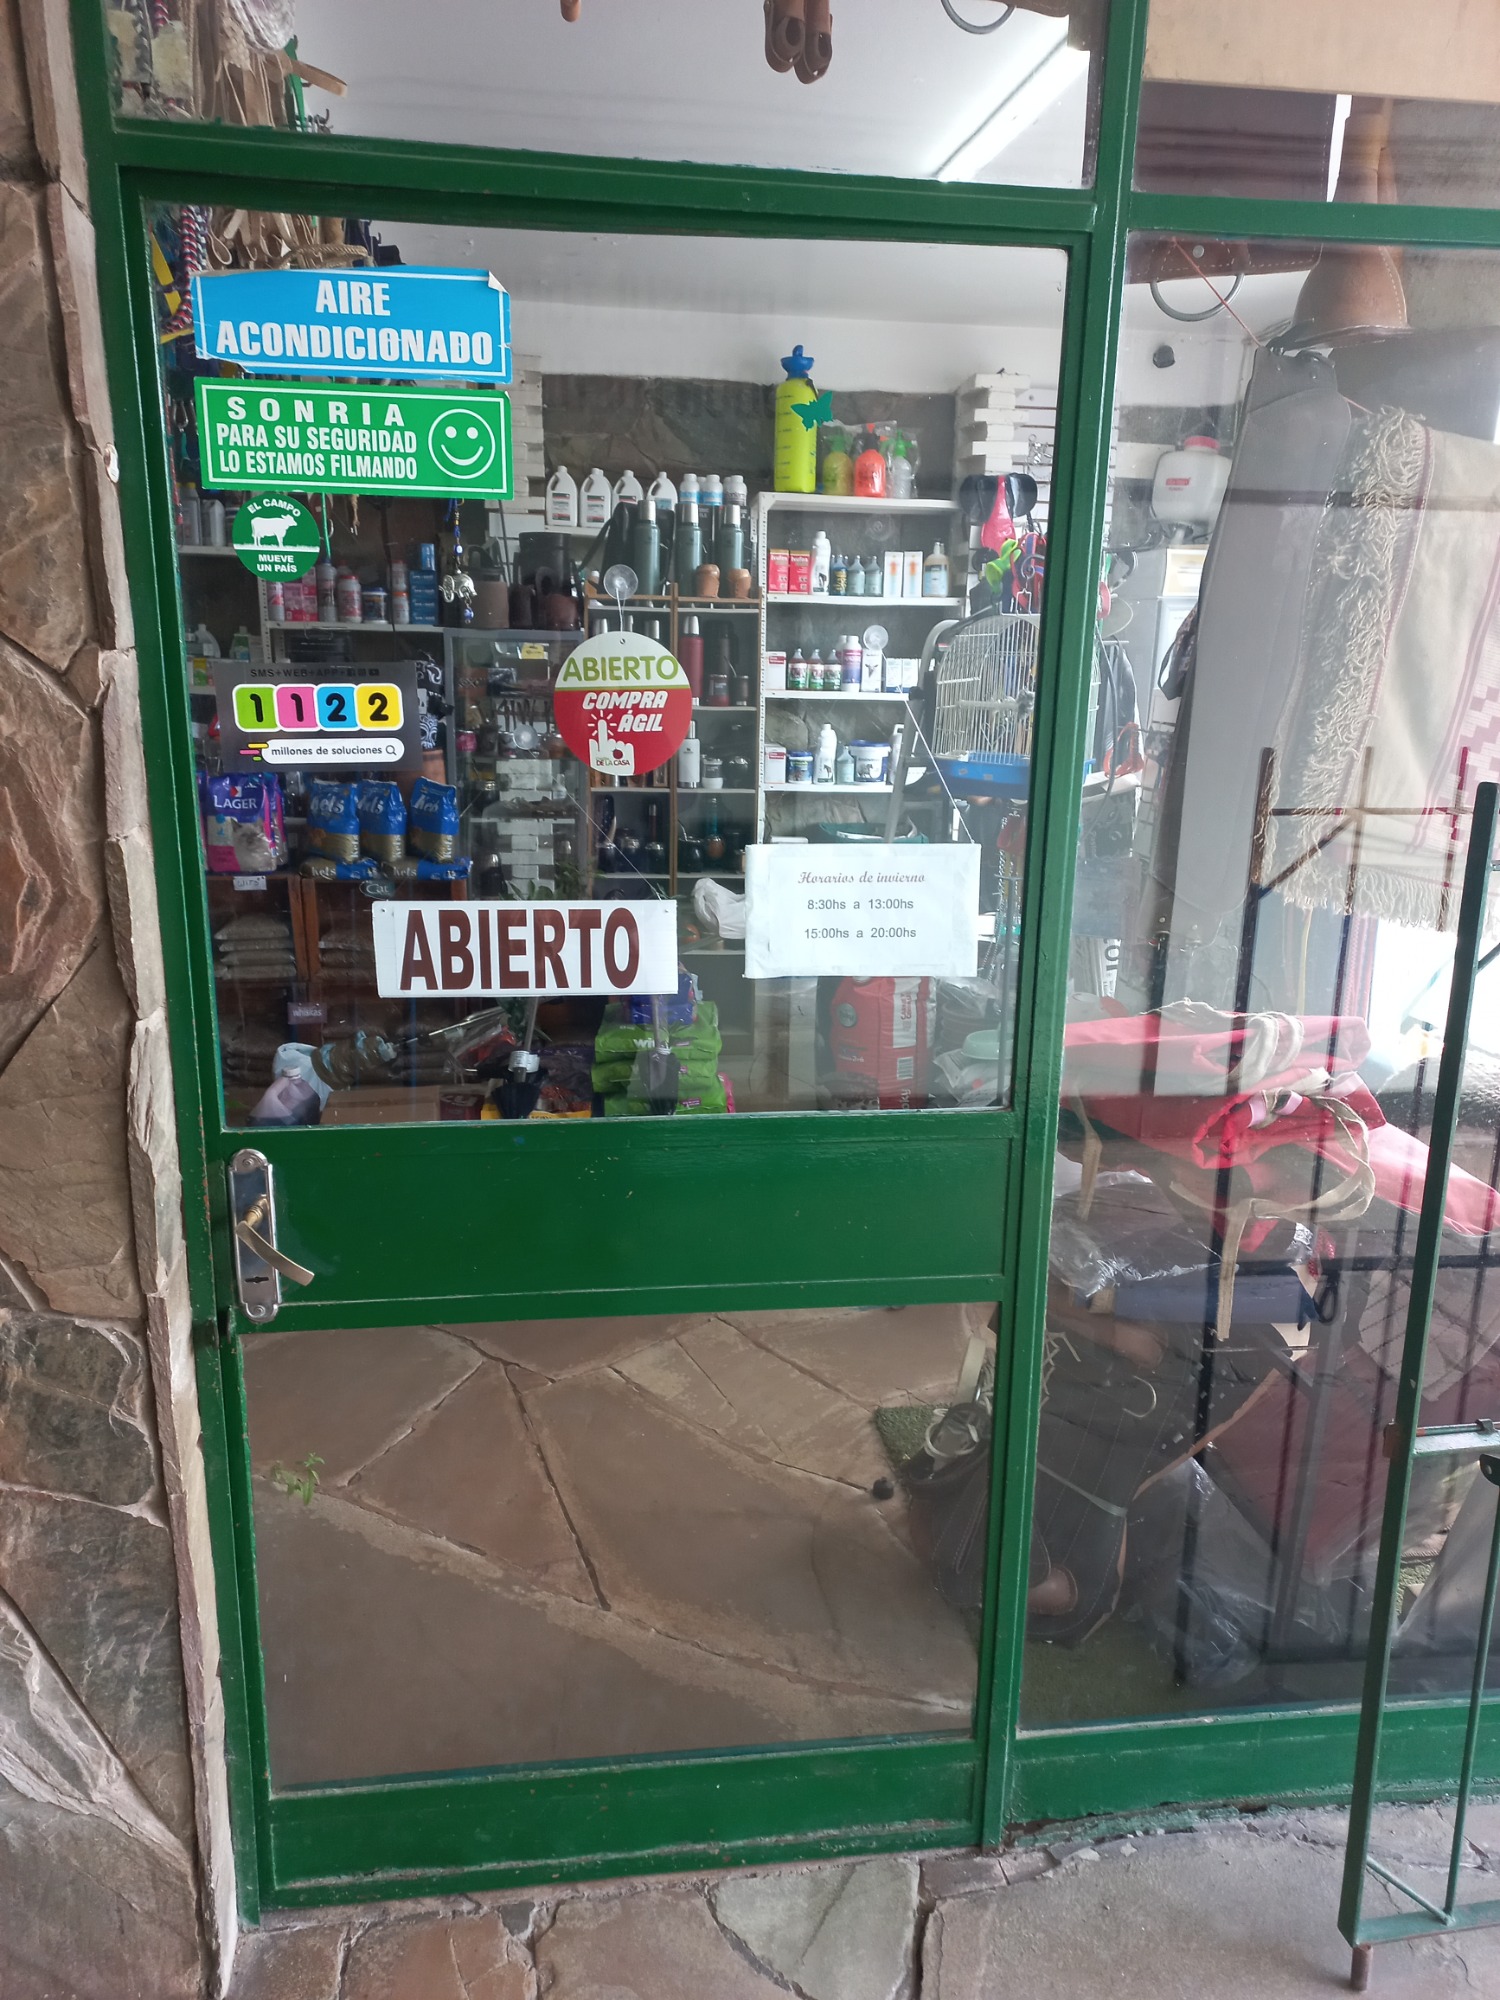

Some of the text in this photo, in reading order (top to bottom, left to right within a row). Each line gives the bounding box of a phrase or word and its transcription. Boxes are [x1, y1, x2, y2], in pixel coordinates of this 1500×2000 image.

[315, 279, 391, 316] AIRE
[216, 320, 493, 365] ACONDICIONADO
[216, 422, 417, 453] PARA SU SEGURIDAD
[219, 450, 417, 480] LO ESTAMOS FILMANDO
[247, 498, 301, 517] EL CAMPO
[256, 563, 297, 572] UN PAÍS
[258, 554, 294, 563] MUEVE
[563, 655, 678, 682] ABIERTO
[582, 690, 668, 710] COMPRA
[617, 709, 662, 732] ÁGIL
[271, 745, 382, 755] millones de soluciones
[213, 794, 257, 810] LAGER
[798, 870, 925, 884] Horarios de invierno
[807, 898, 914, 909] 8:30hs a 13:00hs
[804, 927, 917, 939] 15:00hs a 20:00hs
[399, 907, 640, 990] ABIERTO
